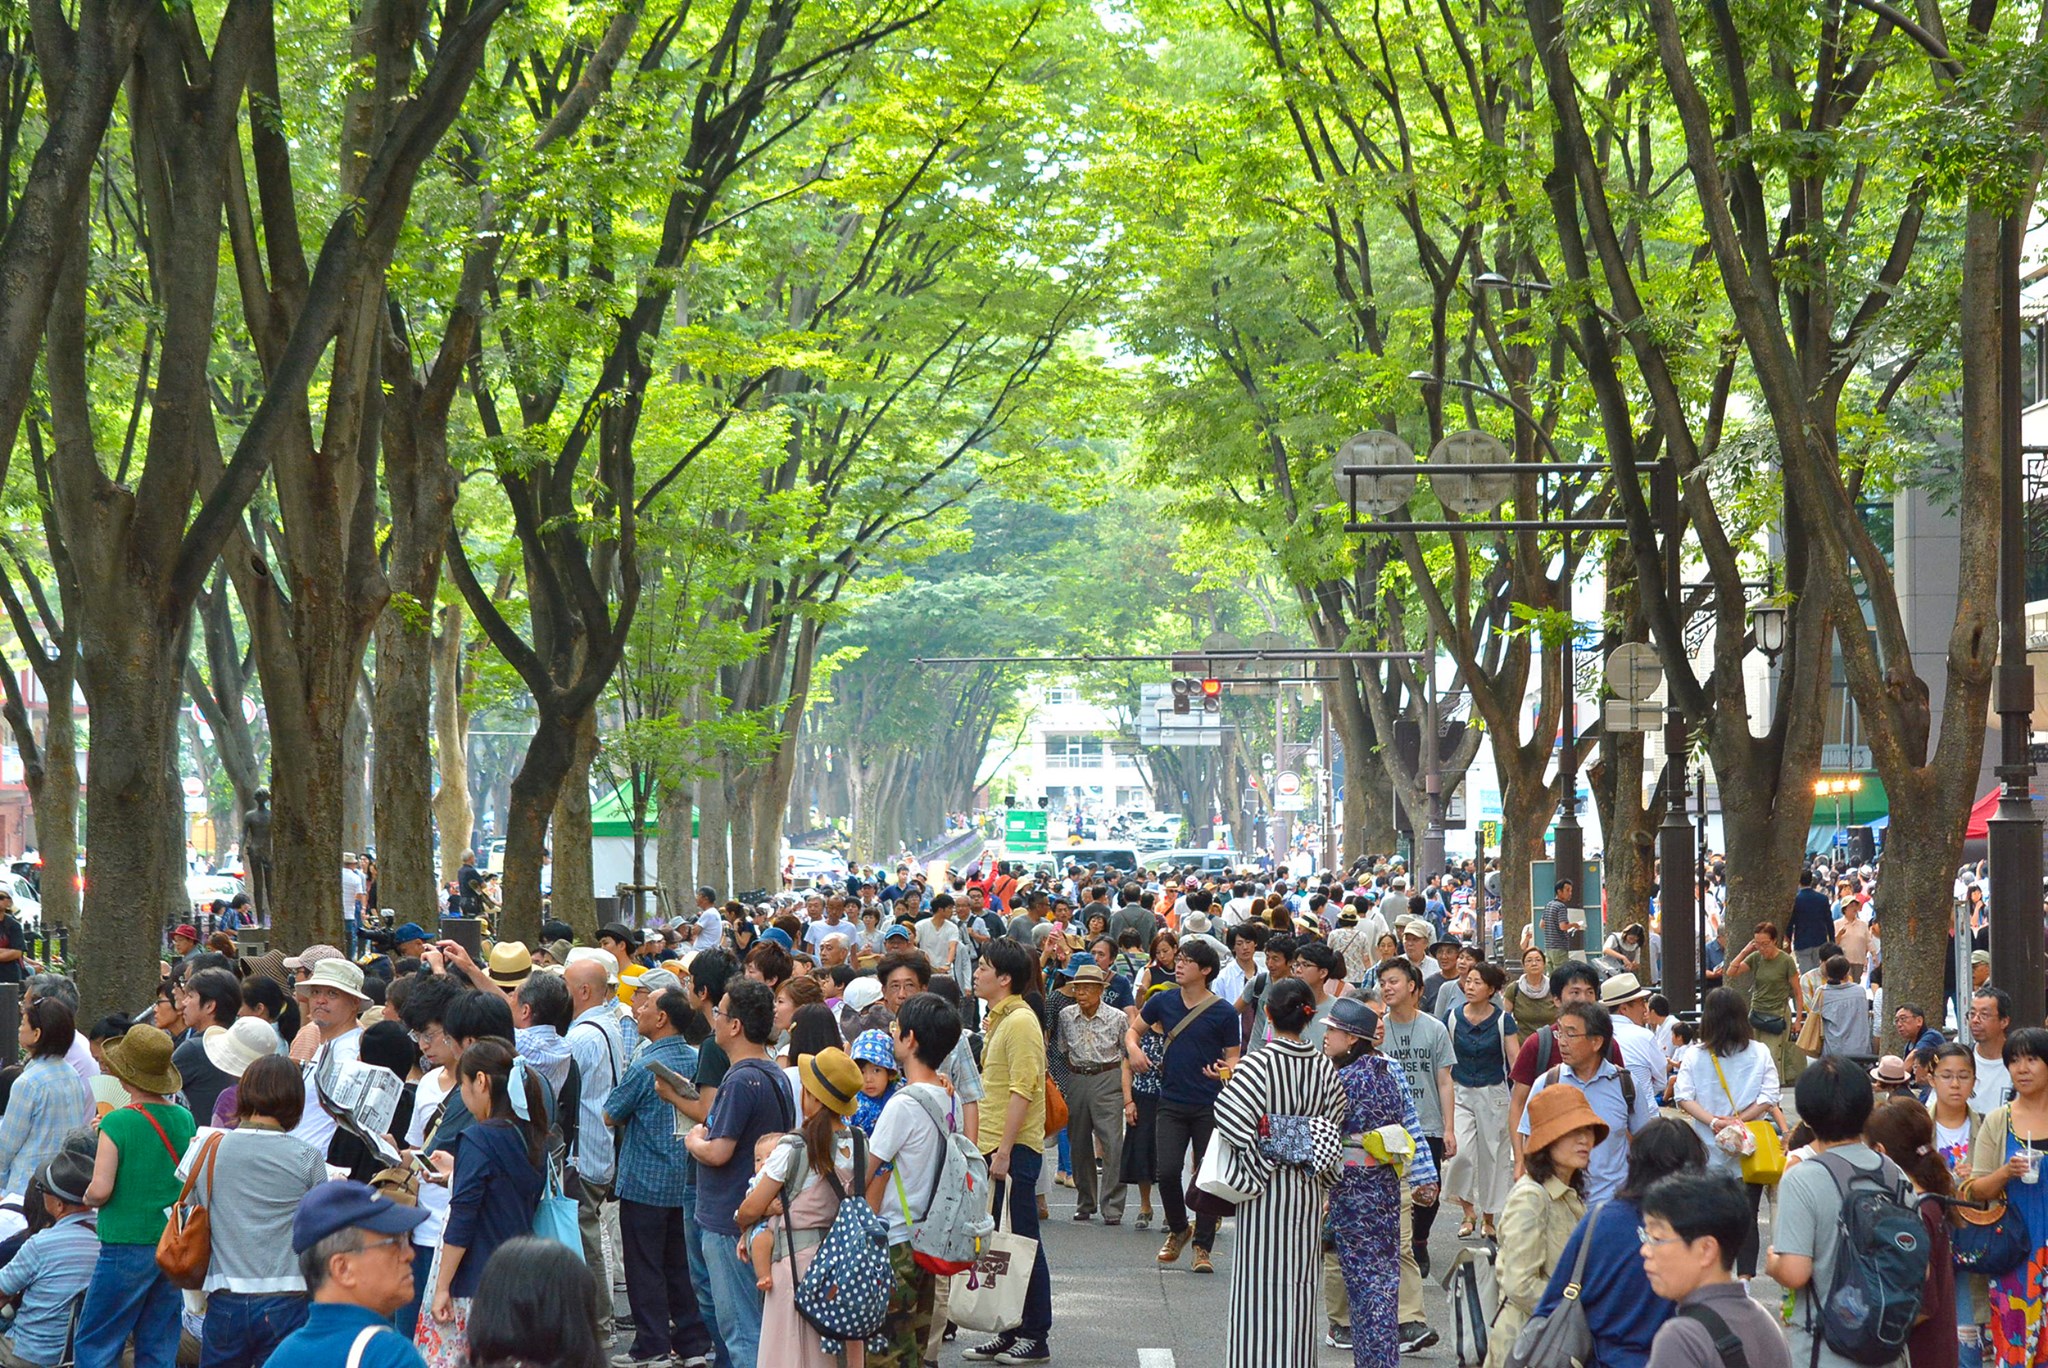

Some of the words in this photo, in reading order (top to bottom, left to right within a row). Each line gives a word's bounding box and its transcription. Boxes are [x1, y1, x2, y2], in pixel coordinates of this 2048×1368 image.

[1400, 1035, 1410, 1046] HI
[1386, 1048, 1412, 1059] HANK
[1413, 1048, 1431, 1059] YOU
[1400, 1061, 1418, 1073] USE
